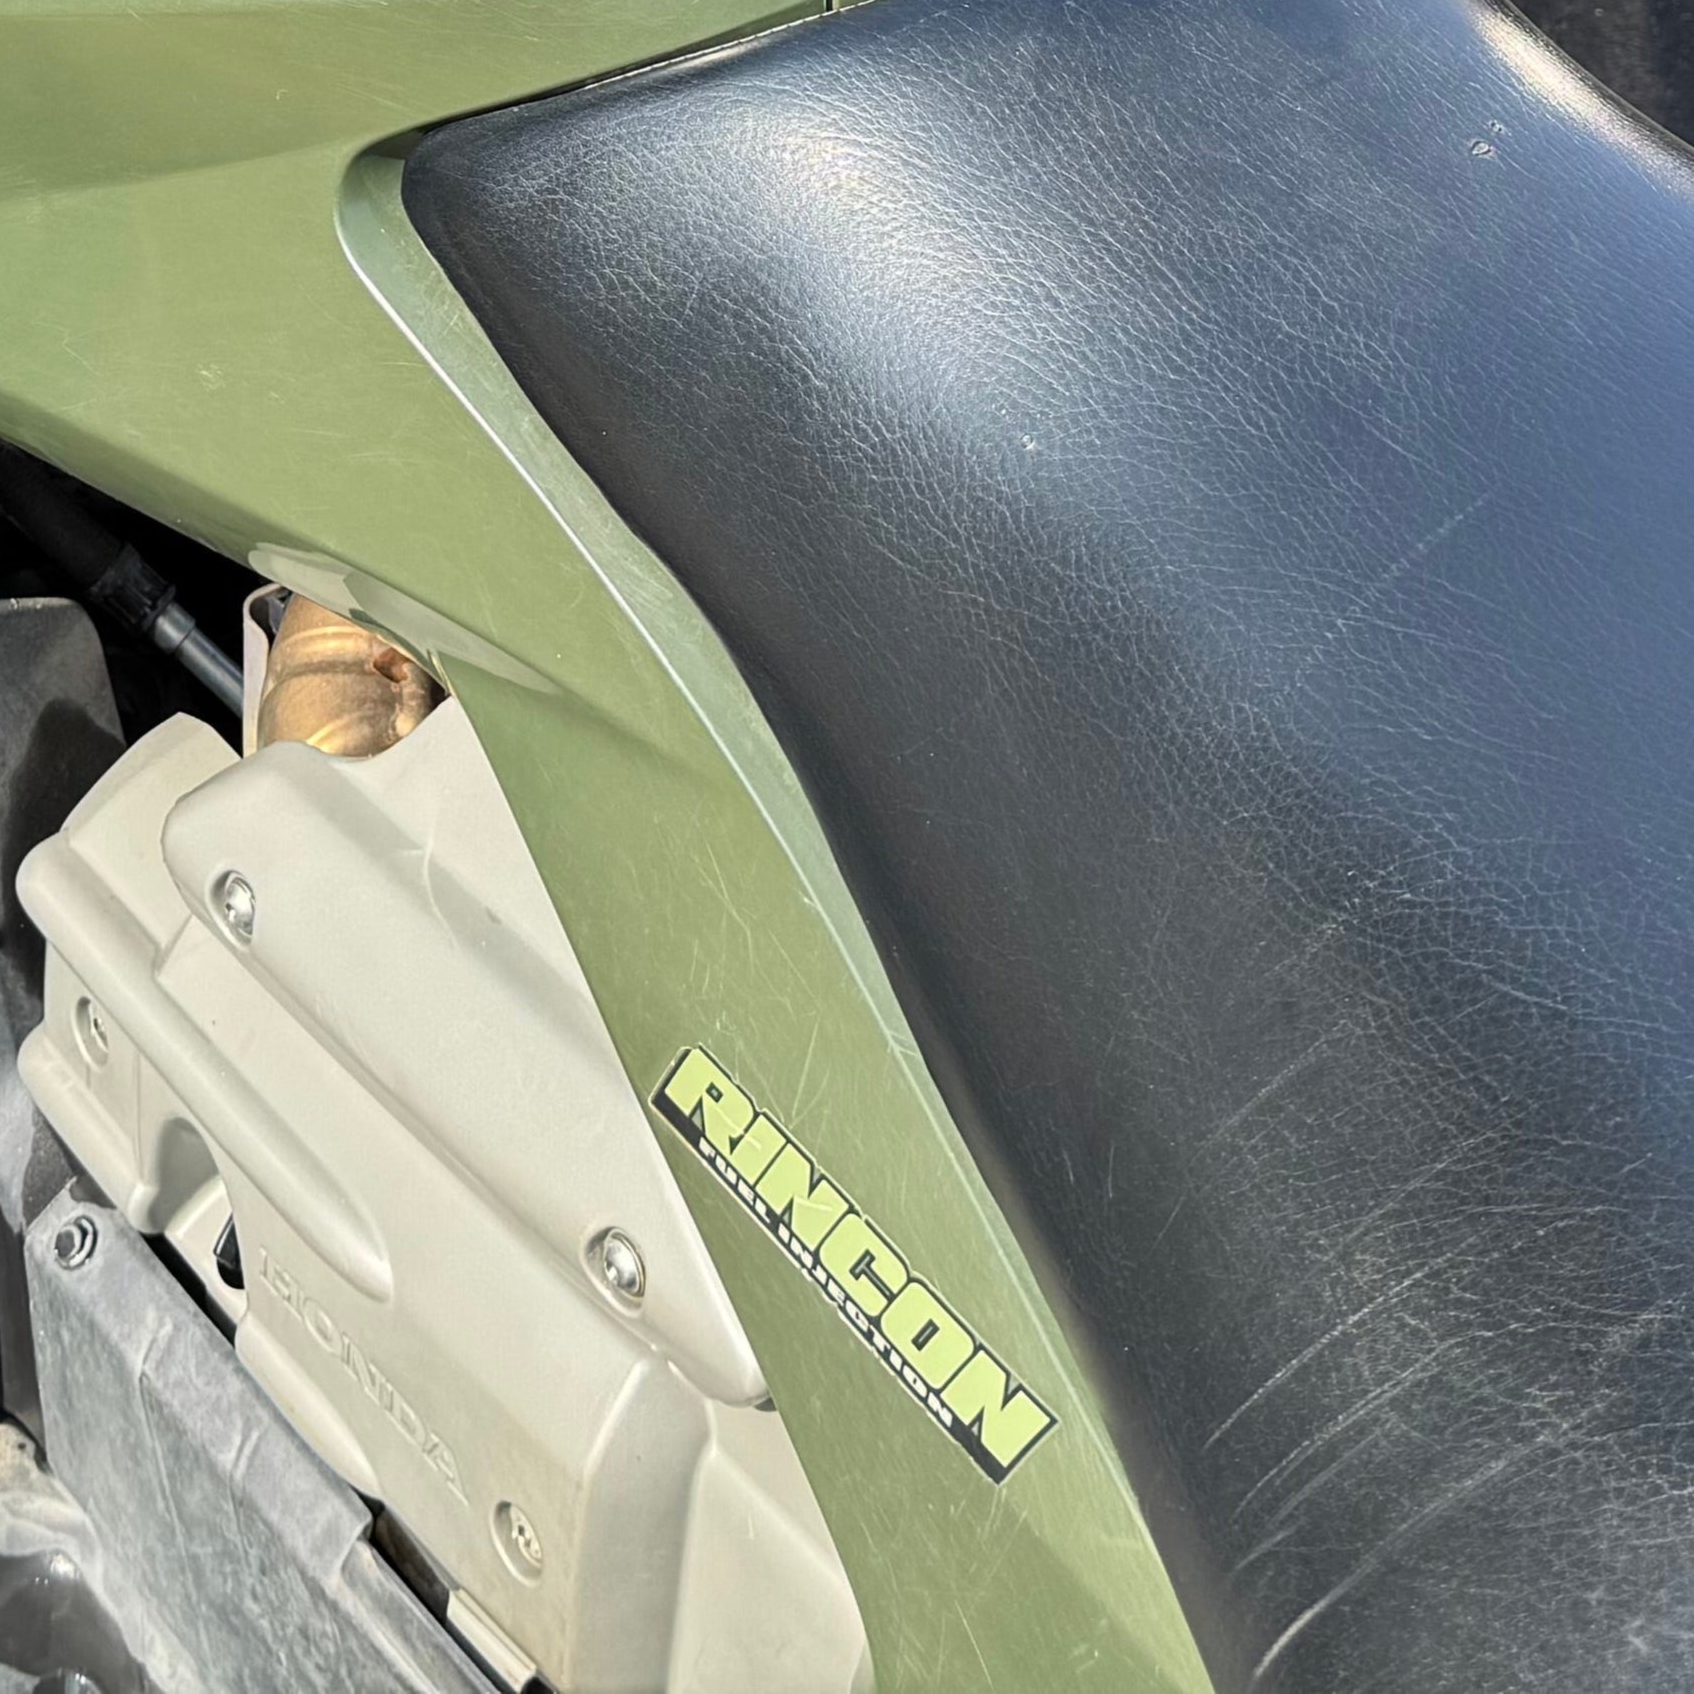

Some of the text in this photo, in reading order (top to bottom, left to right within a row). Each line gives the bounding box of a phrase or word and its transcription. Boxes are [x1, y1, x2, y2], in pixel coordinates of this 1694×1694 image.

[257, 1245, 473, 1506] HONDA
[662, 1047, 1052, 1469] RINCON
[697, 1135, 954, 1429] FUEL INJECTION
